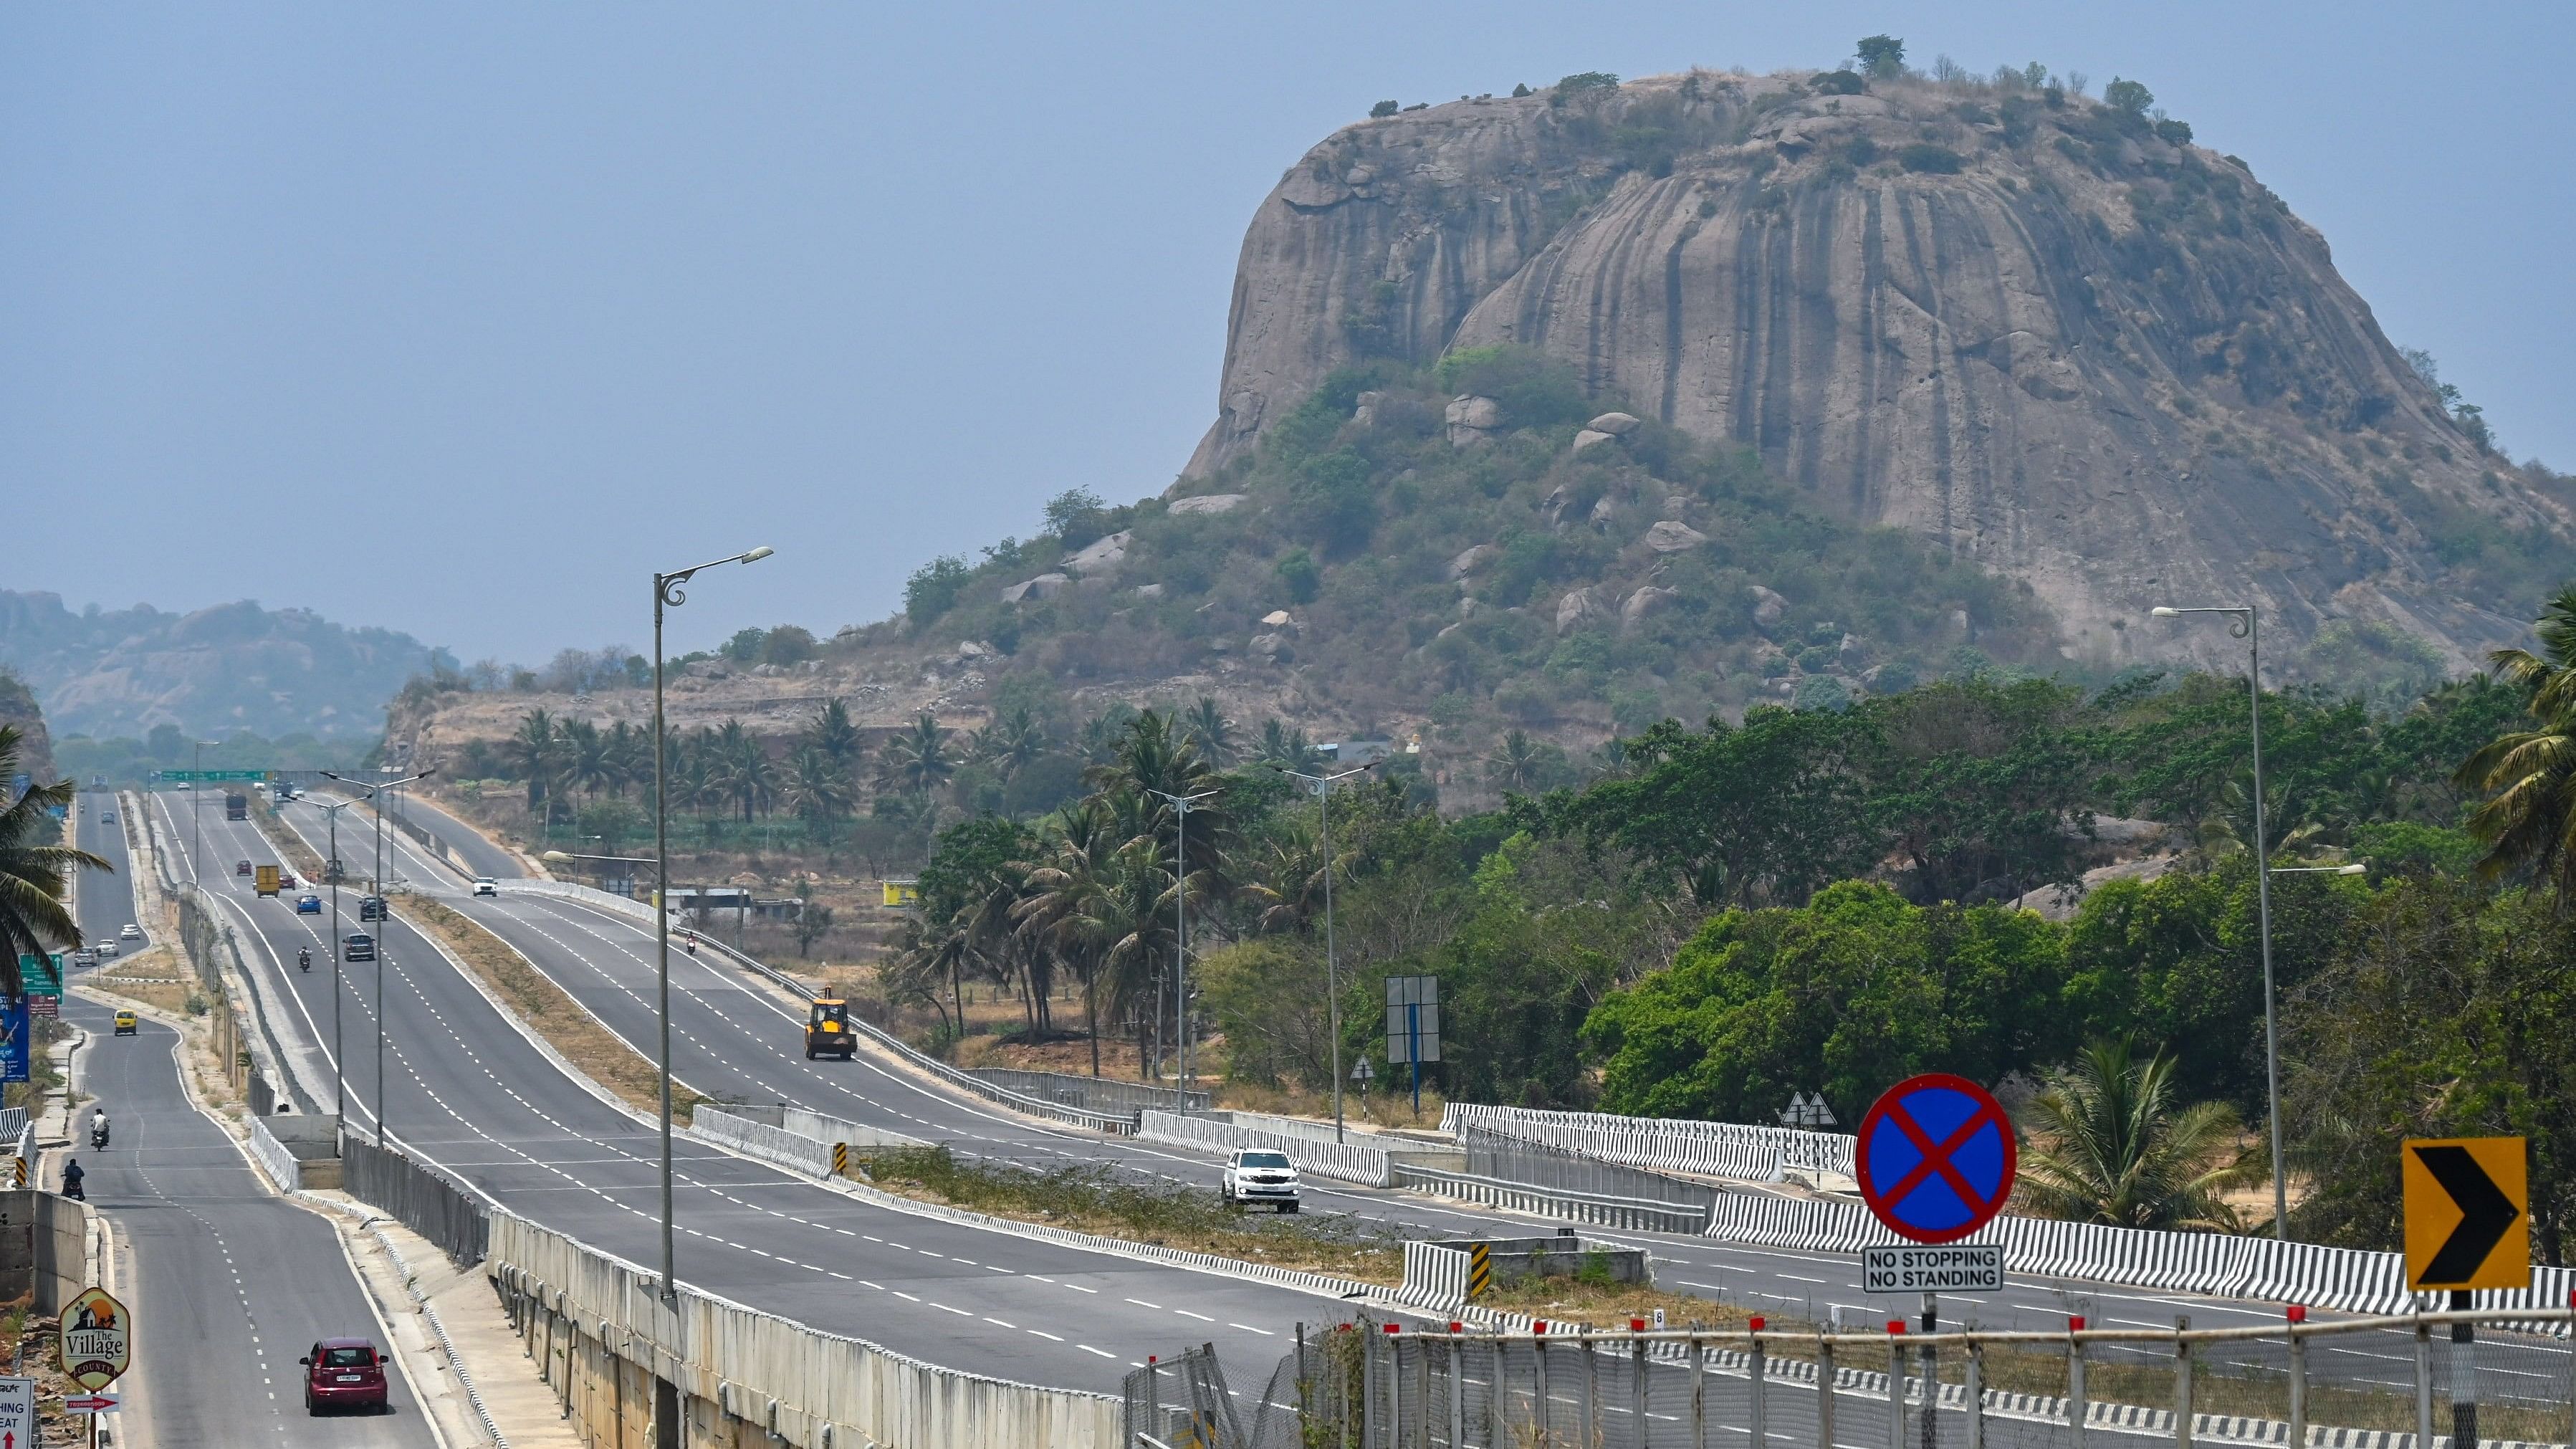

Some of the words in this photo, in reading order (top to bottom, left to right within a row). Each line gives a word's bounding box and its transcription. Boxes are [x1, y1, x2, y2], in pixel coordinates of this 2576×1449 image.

[1870, 1252, 1897, 1268] NO
[1902, 1251, 1996, 1267] STOPPING
[1870, 1271, 1897, 1287] NO
[1902, 1270, 1996, 1286] STANDING
[1657, 1312, 1662, 1323] 8
[95, 1331, 112, 1341] The
[66, 1335, 123, 1359] Village
[77, 1362, 112, 1374] COUNTY
